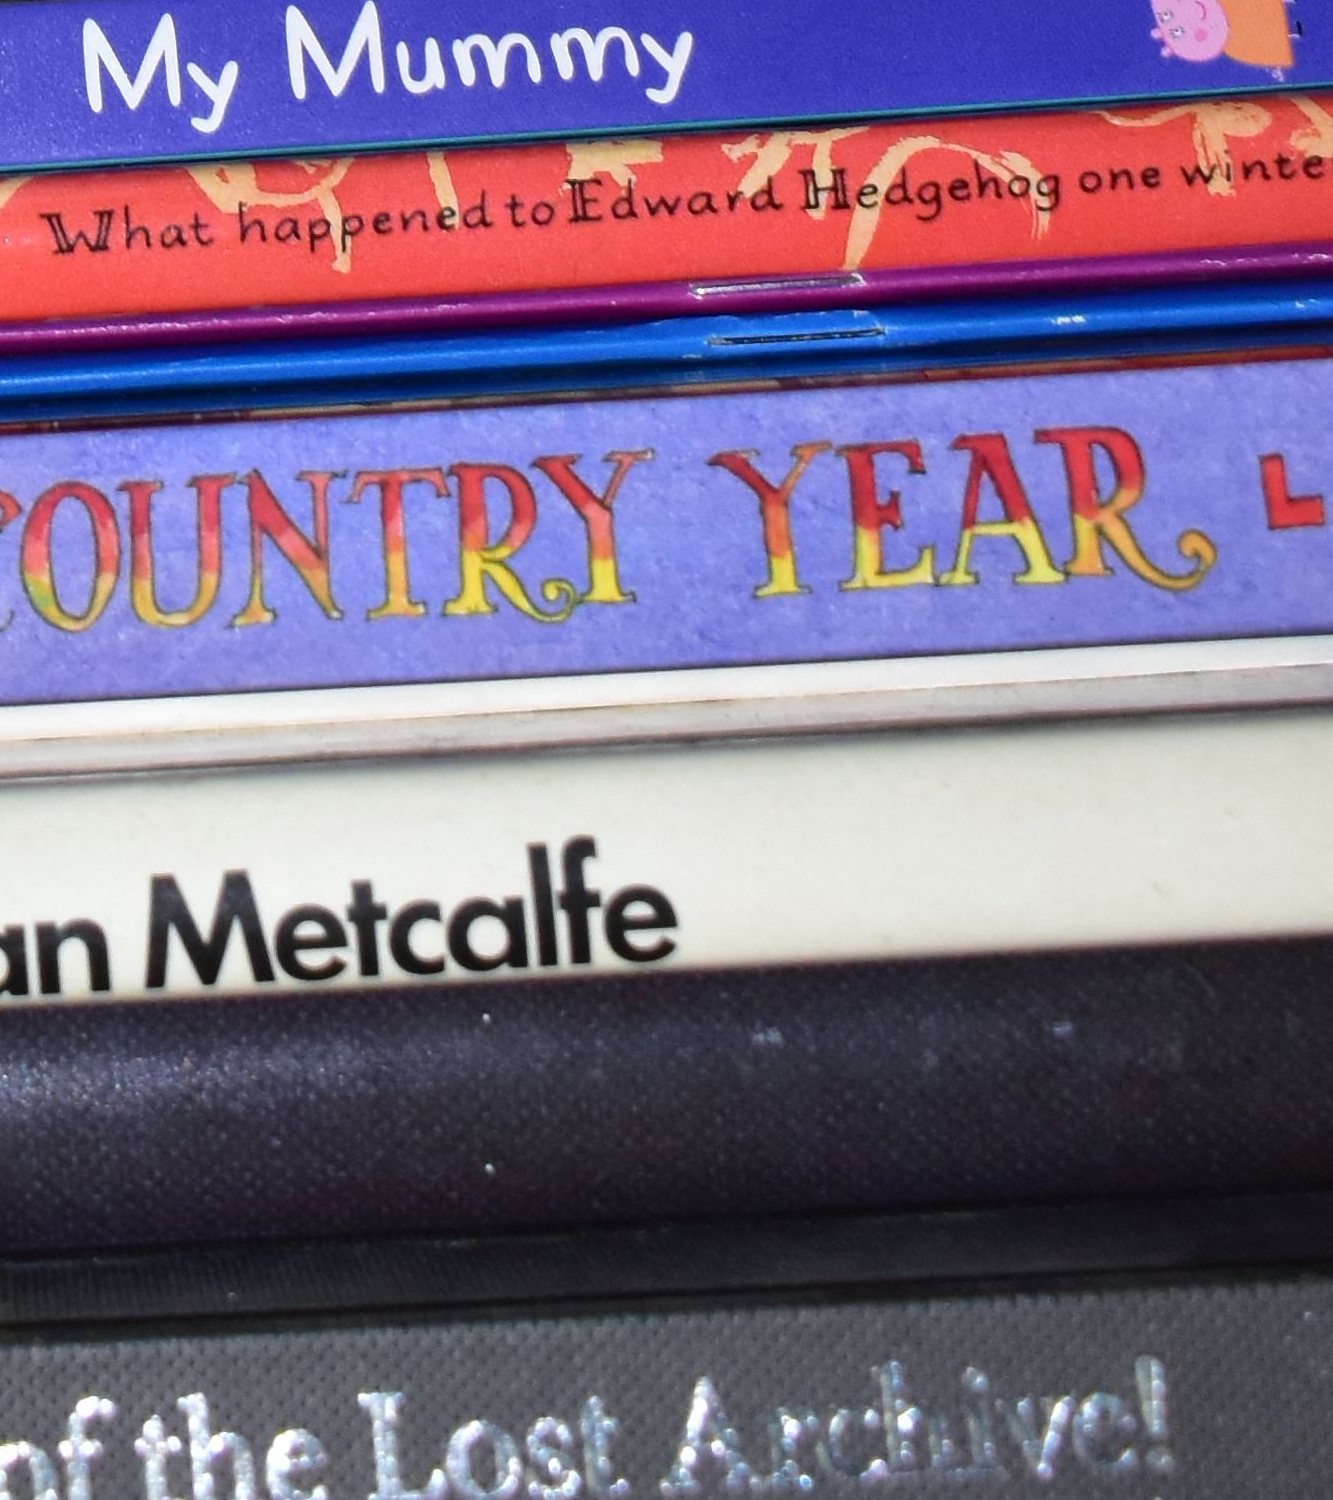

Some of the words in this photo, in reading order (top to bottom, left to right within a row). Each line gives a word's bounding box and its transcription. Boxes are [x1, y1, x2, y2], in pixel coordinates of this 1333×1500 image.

[81, 13, 239, 134] My
[286, 0, 693, 106] Mummy
[41, 206, 213, 257] What
[238, 200, 497, 248] happened
[507, 195, 556, 227] to
[566, 176, 779, 225] Edward
[800, 166, 1061, 222] Hedgehog
[1078, 161, 1161, 195] one
[710, 425, 1218, 599] YEAR
[147, 836, 680, 991] Metcalfe
[134, 1392, 328, 1500] the
[356, 1390, 630, 1499] Lost
